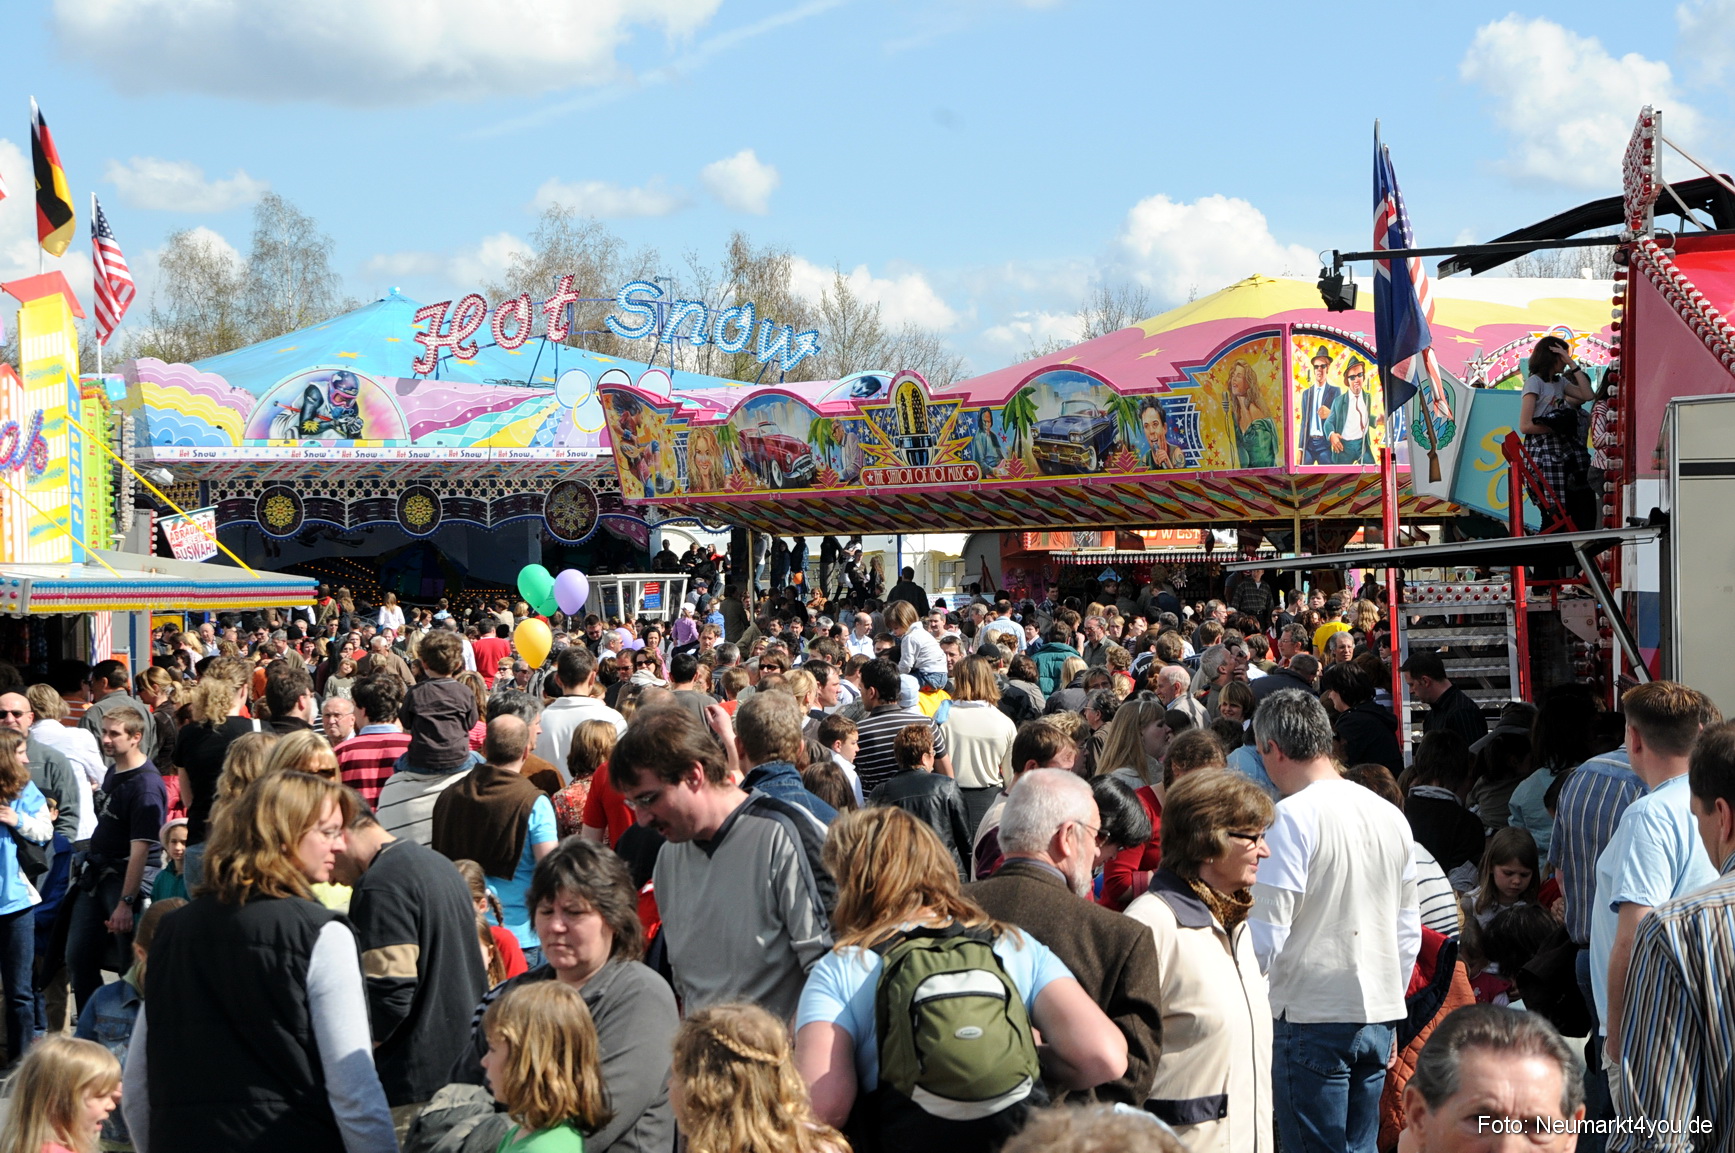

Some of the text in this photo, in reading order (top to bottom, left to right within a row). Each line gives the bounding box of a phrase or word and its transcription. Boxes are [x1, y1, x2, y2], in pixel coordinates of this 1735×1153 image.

[412, 274, 820, 375] Hot Snow
[874, 466, 968, 484] THE STATION OF HOT MUSIC
[175, 543, 216, 560] AUSWAHL
